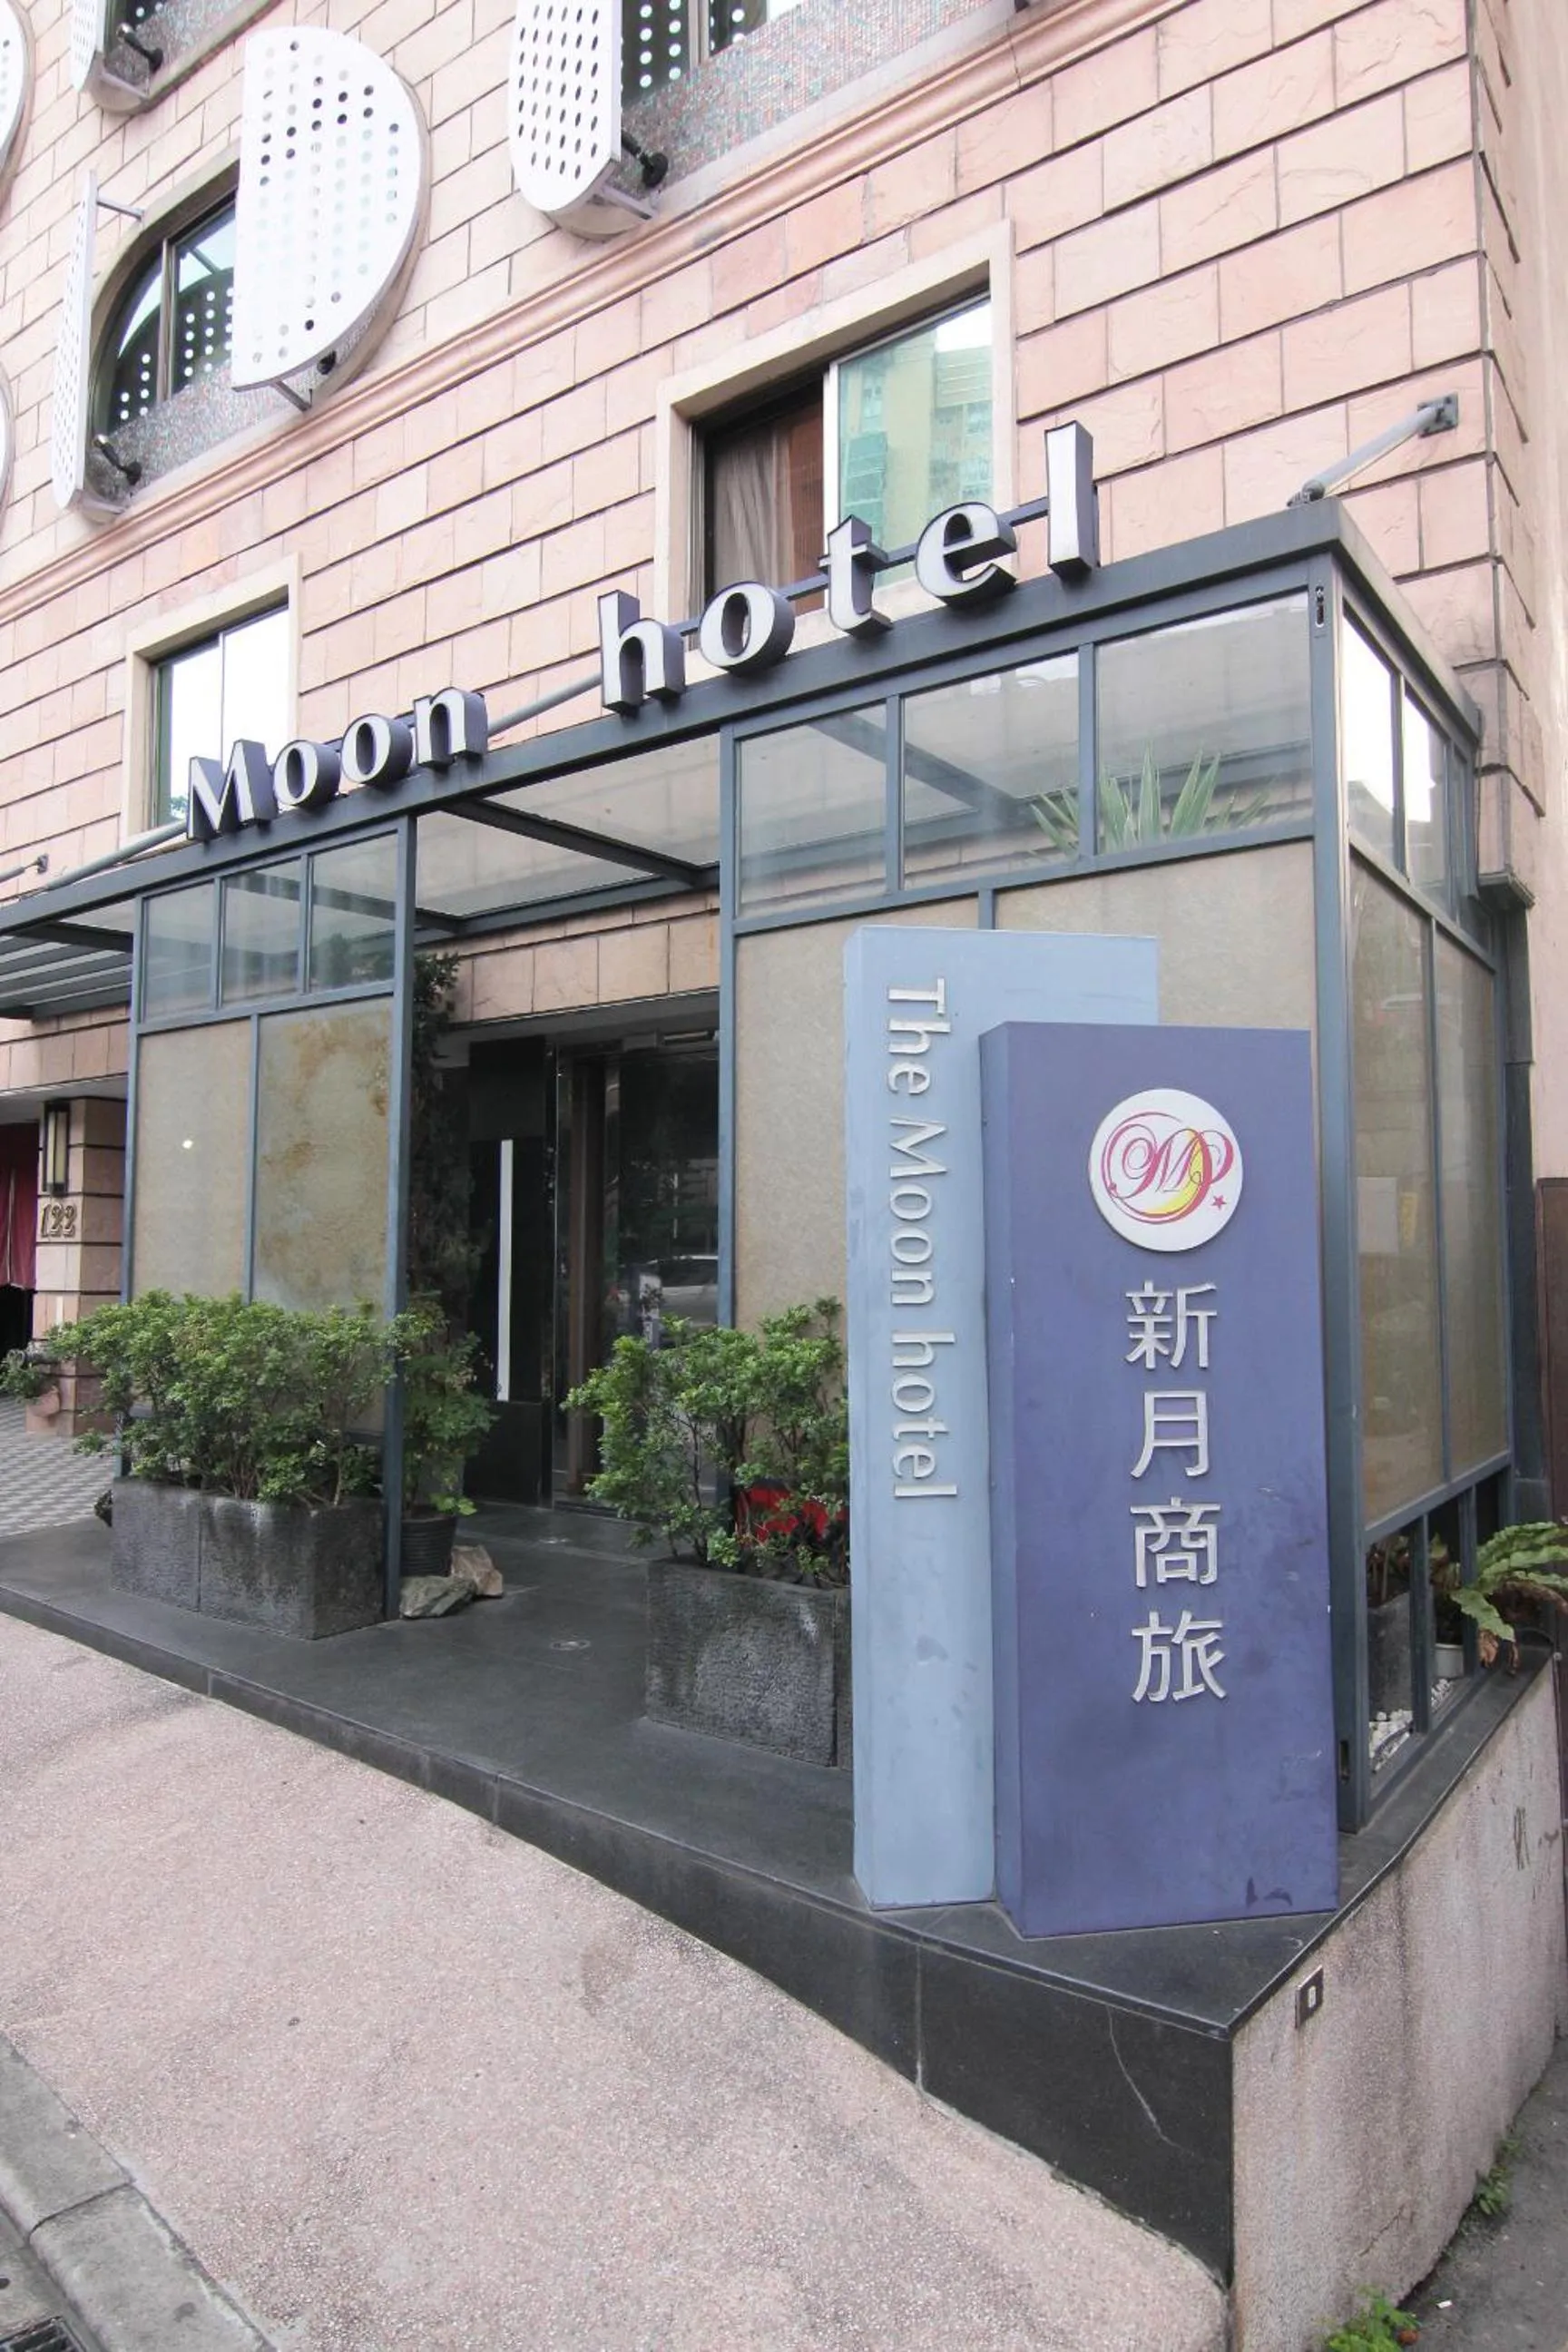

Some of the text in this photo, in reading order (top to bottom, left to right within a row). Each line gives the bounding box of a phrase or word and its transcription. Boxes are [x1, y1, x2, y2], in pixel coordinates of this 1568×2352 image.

[186, 420, 1100, 840] Moon hotel
[41, 1202, 76, 1238] 122
[888, 977, 958, 1499] The Moon hotel
[1125, 1279, 1228, 1703] 新月商旅
